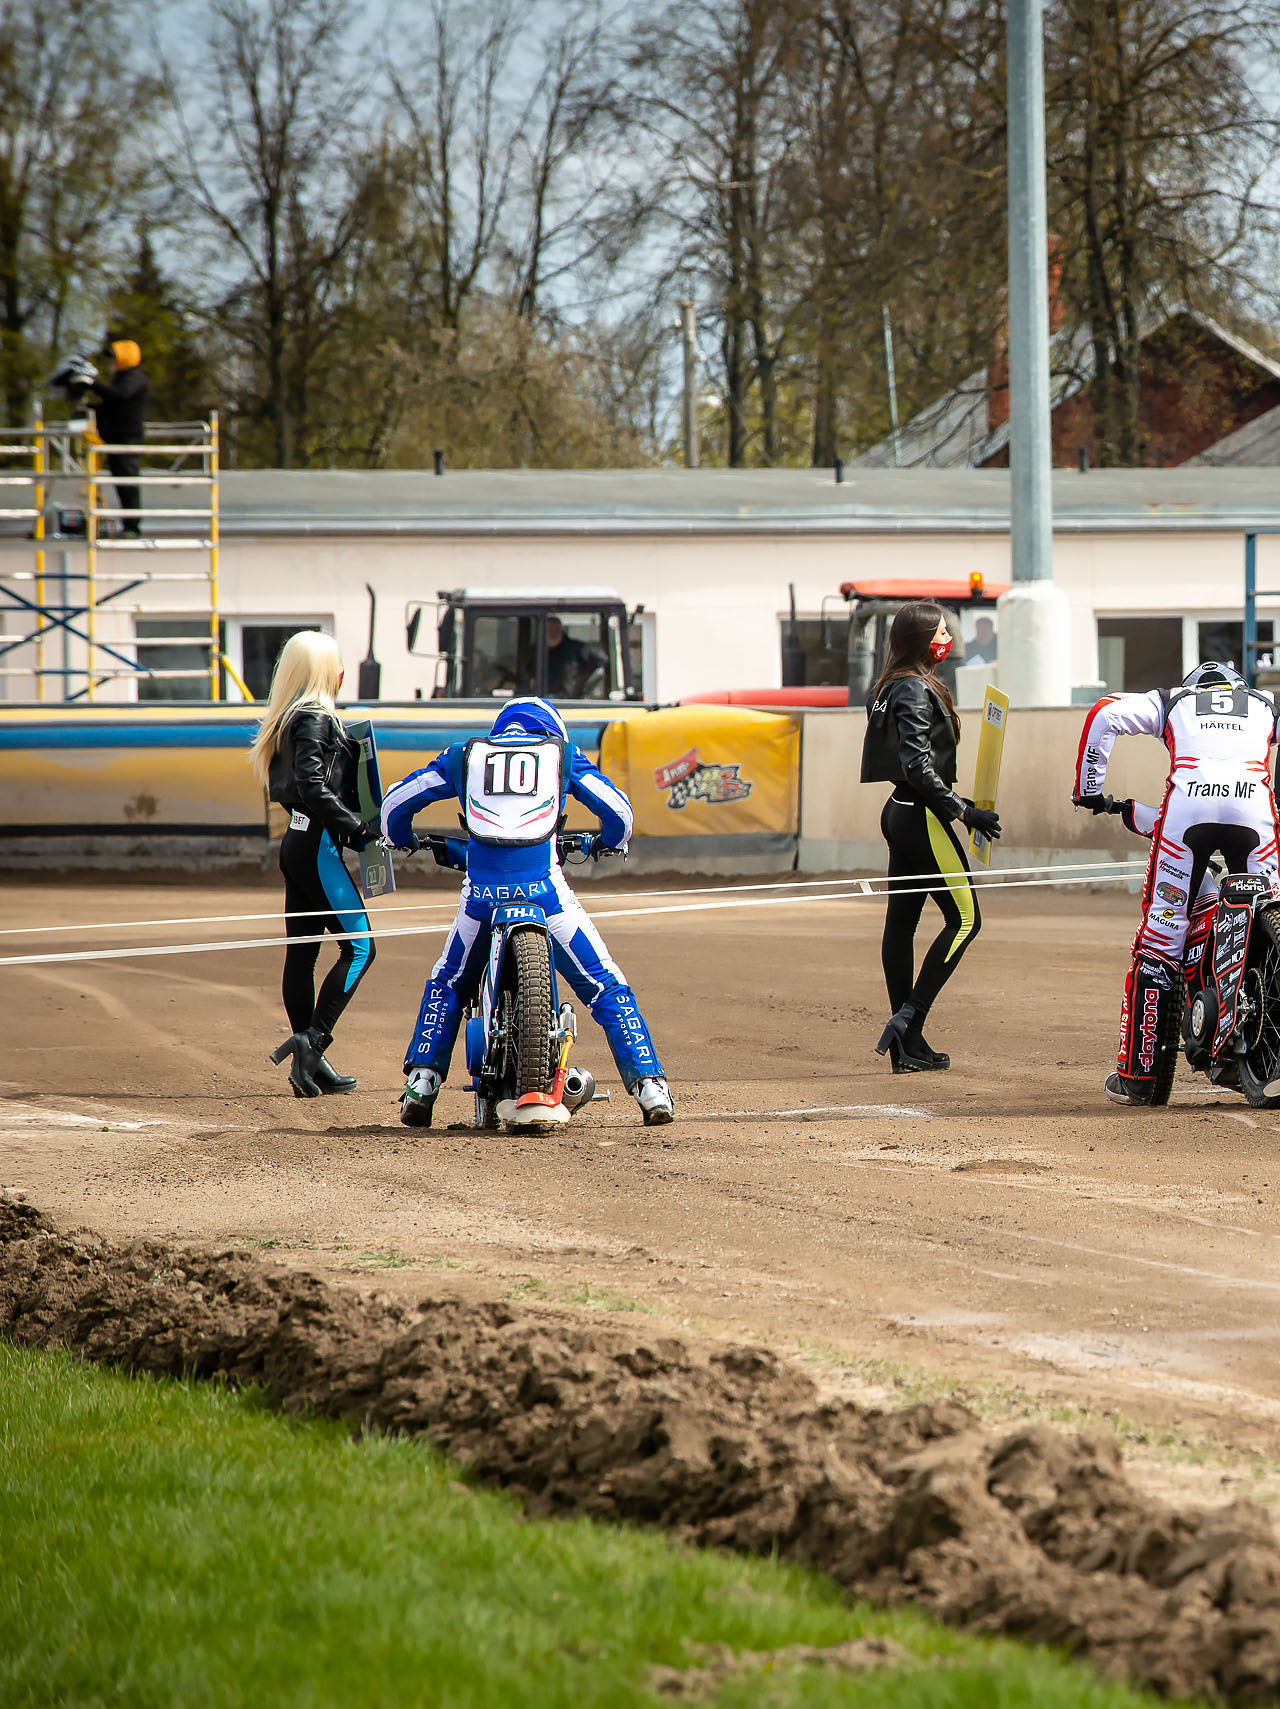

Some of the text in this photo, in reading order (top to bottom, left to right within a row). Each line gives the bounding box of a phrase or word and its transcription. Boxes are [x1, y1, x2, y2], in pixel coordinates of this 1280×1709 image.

[1210, 691, 1234, 713] 5
[1200, 720, 1244, 731] HÄRTEL
[486, 753, 537, 794] 10
[1084, 746, 1100, 795] Trans MF
[1186, 781, 1257, 799] Trans MF
[473, 880, 548, 899] SAGARI
[1235, 882, 1266, 892] Härtel
[1149, 912, 1180, 931] MAGURA
[417, 981, 443, 1054] SAGAR
[436, 1002, 449, 1035] SPORTS
[616, 1013, 632, 1046] SPORTS
[616, 995, 653, 1065] SAGARI
[1139, 988, 1159, 1073] daytona
